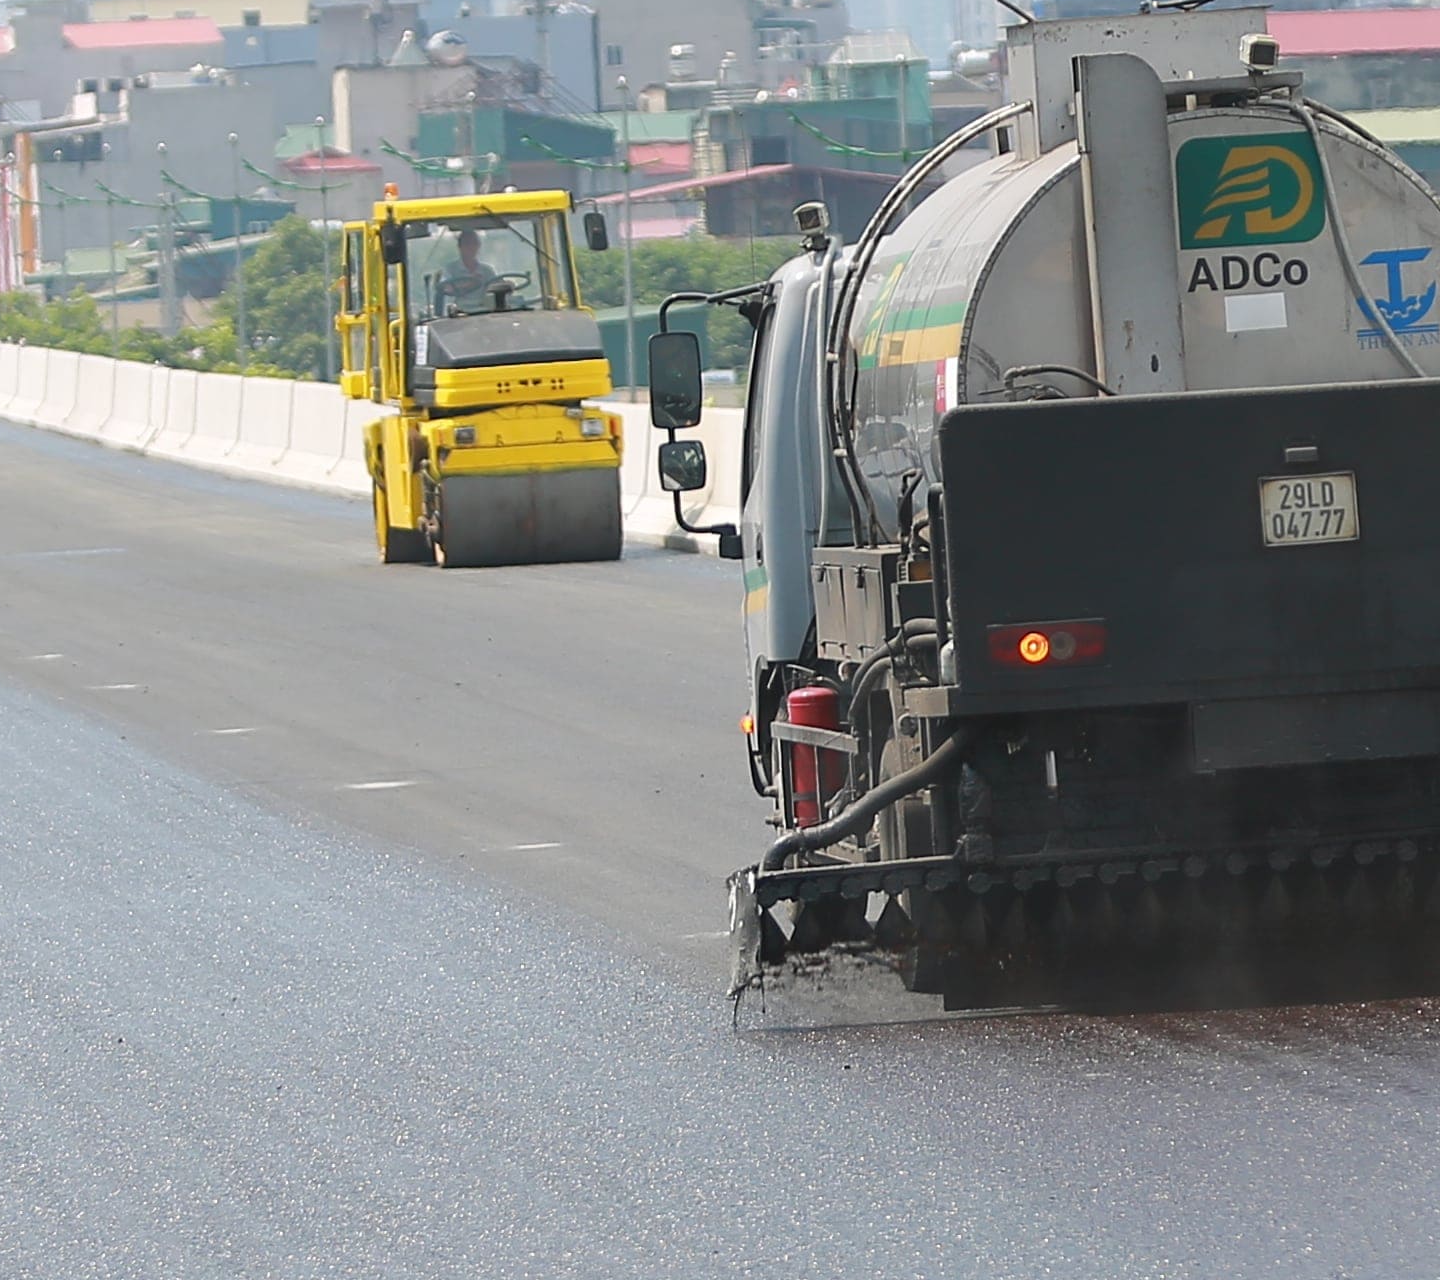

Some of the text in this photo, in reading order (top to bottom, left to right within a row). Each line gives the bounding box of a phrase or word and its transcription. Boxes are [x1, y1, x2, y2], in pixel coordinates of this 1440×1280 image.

[1187, 252, 1309, 293] ADCo
[1357, 332, 1440, 351] THUN AN
[1279, 481, 1334, 510] 29LD
[1272, 508, 1345, 539] 047.77
